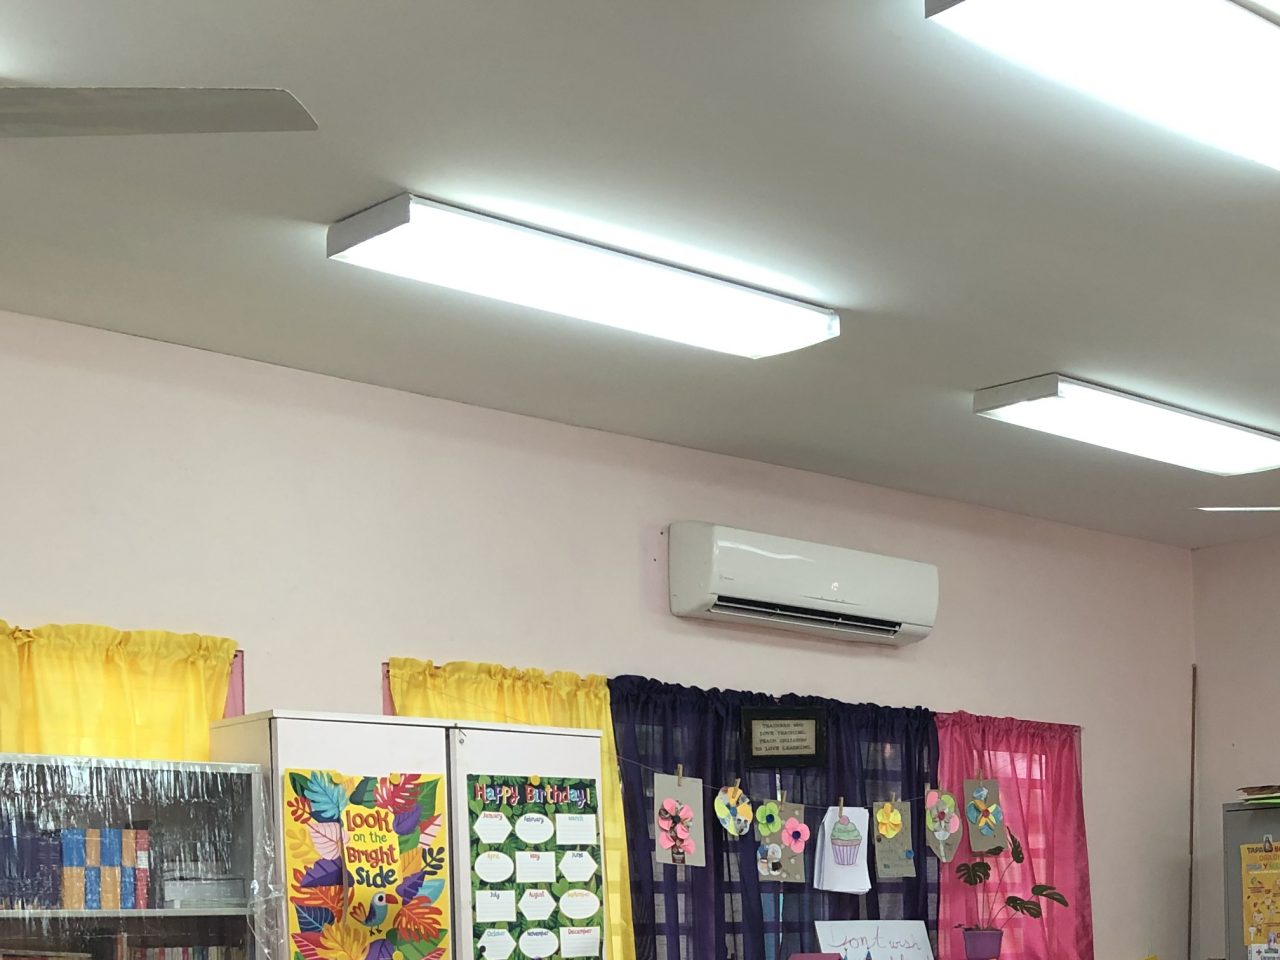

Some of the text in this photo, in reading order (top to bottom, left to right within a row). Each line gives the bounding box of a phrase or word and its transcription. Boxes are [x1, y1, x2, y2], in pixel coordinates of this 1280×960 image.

[474, 783, 592, 809] Happy Birthday!
[352, 831, 388, 844] on the
